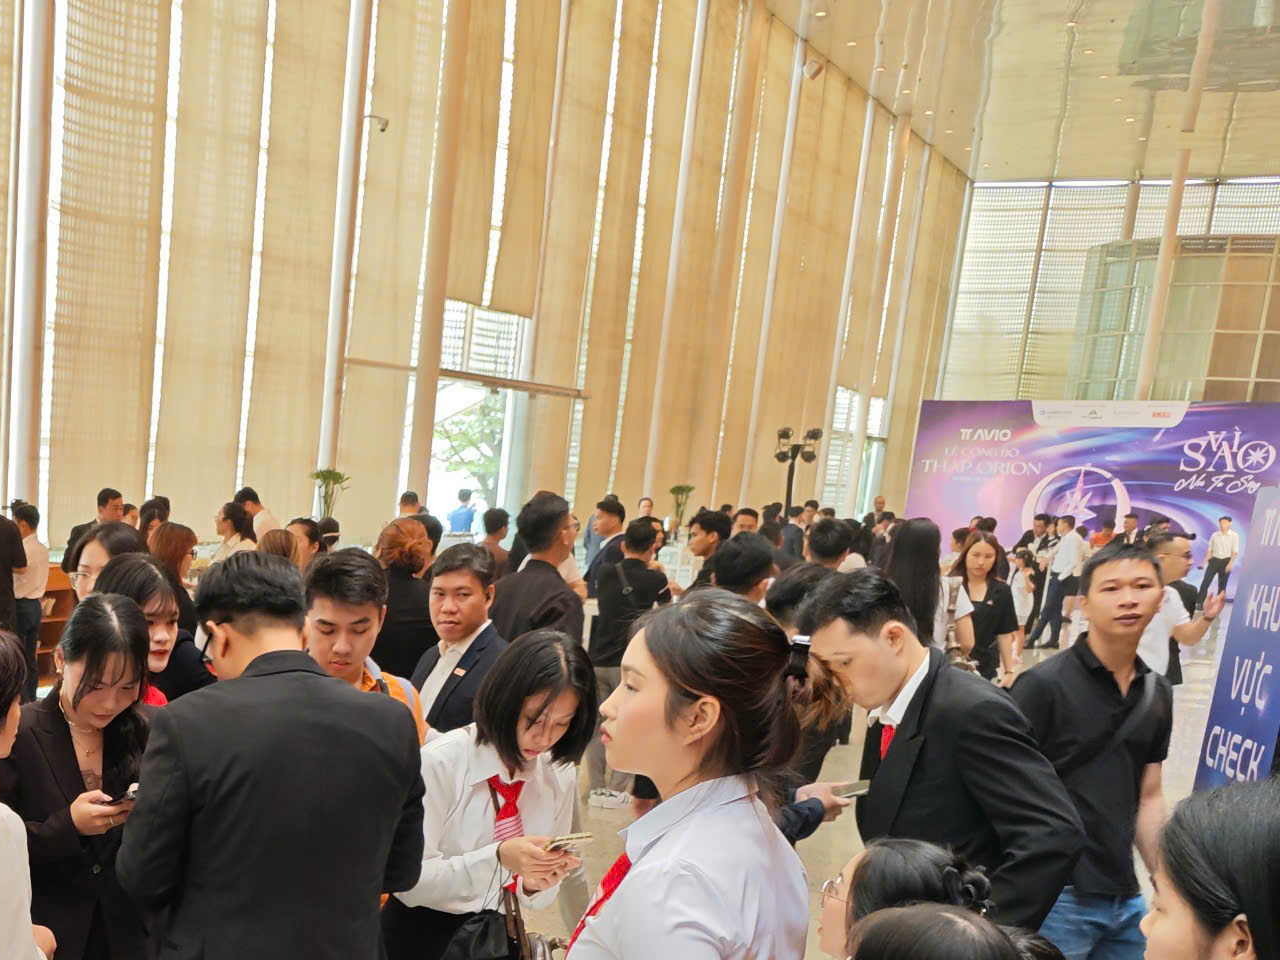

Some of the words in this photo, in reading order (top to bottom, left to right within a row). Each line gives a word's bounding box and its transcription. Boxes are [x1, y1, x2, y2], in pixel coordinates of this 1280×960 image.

[1207, 425, 1243, 453] VÌ
[975, 461, 1043, 476] ORION
[1179, 440, 1277, 474] SAO
[1231, 651, 1273, 716] VỰC
[1205, 725, 1266, 782] CHECK
